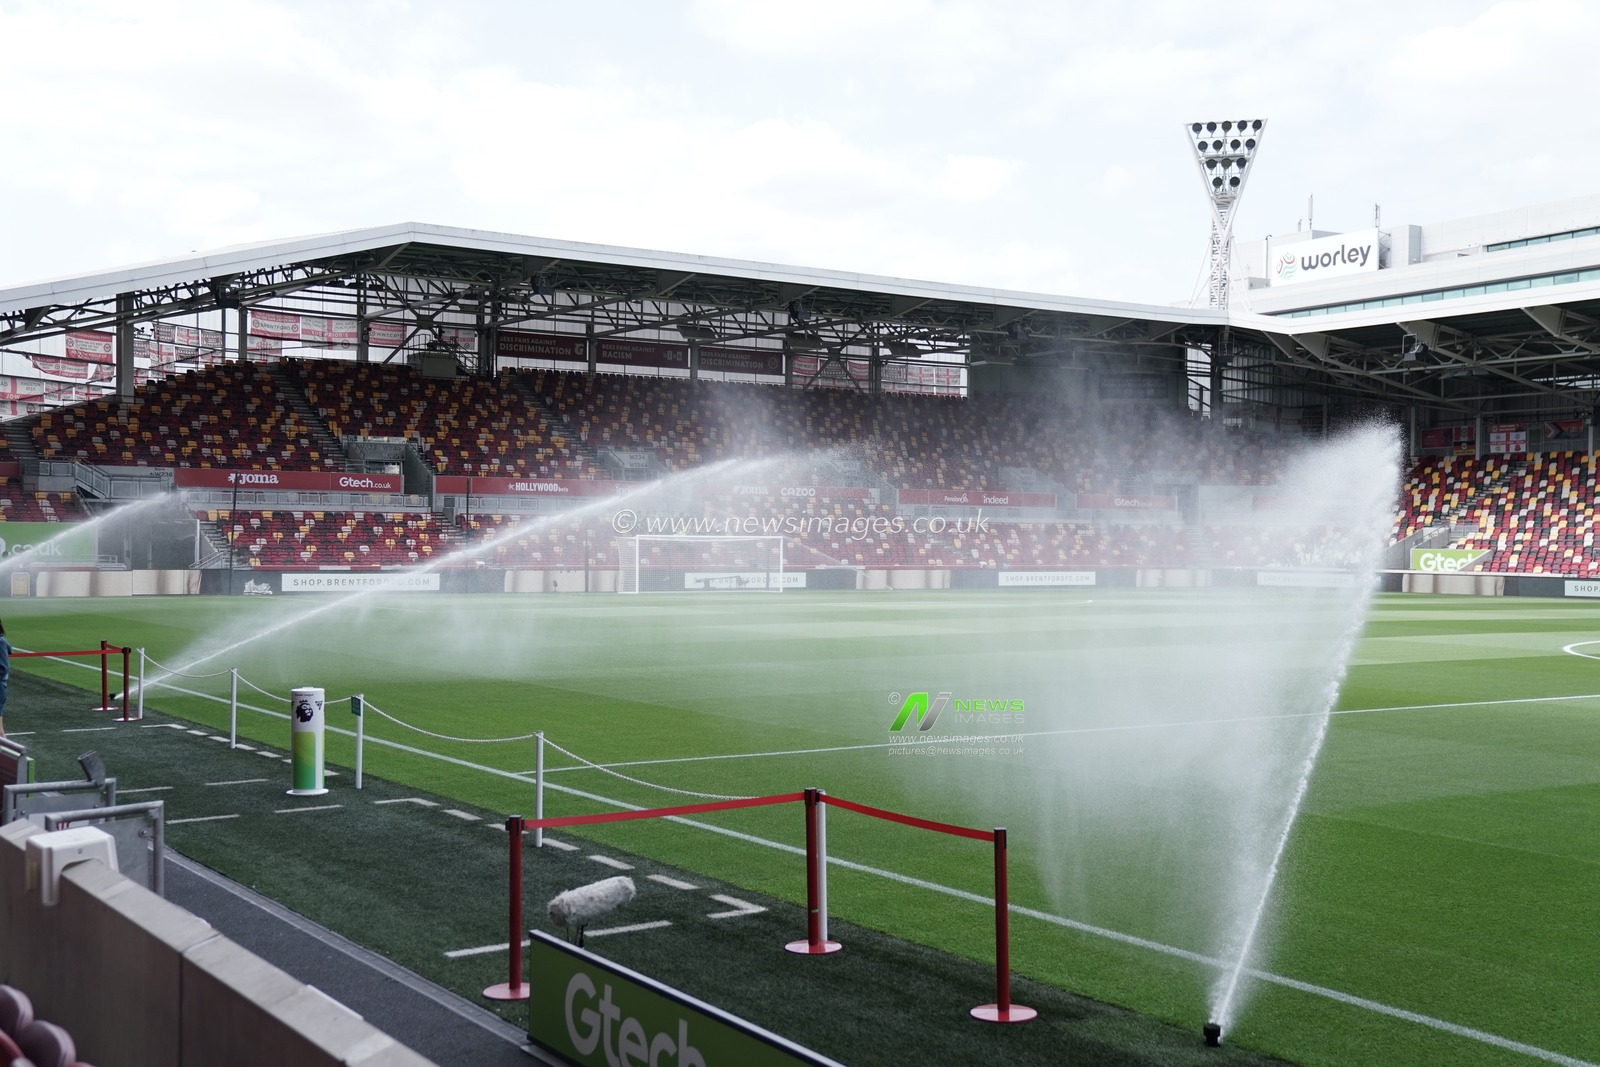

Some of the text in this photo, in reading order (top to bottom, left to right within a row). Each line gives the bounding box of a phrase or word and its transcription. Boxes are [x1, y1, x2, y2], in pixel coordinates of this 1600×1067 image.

[1301, 244, 1371, 271] worley
[500, 342, 571, 355] DISCRIMINATION
[602, 350, 632, 360] RACISM
[701, 358, 764, 369] DISCRIMINATION
[339, 476, 392, 489] Gtech.co.uk
[780, 487, 816, 497] CAZOO
[983, 493, 1009, 504] indeed
